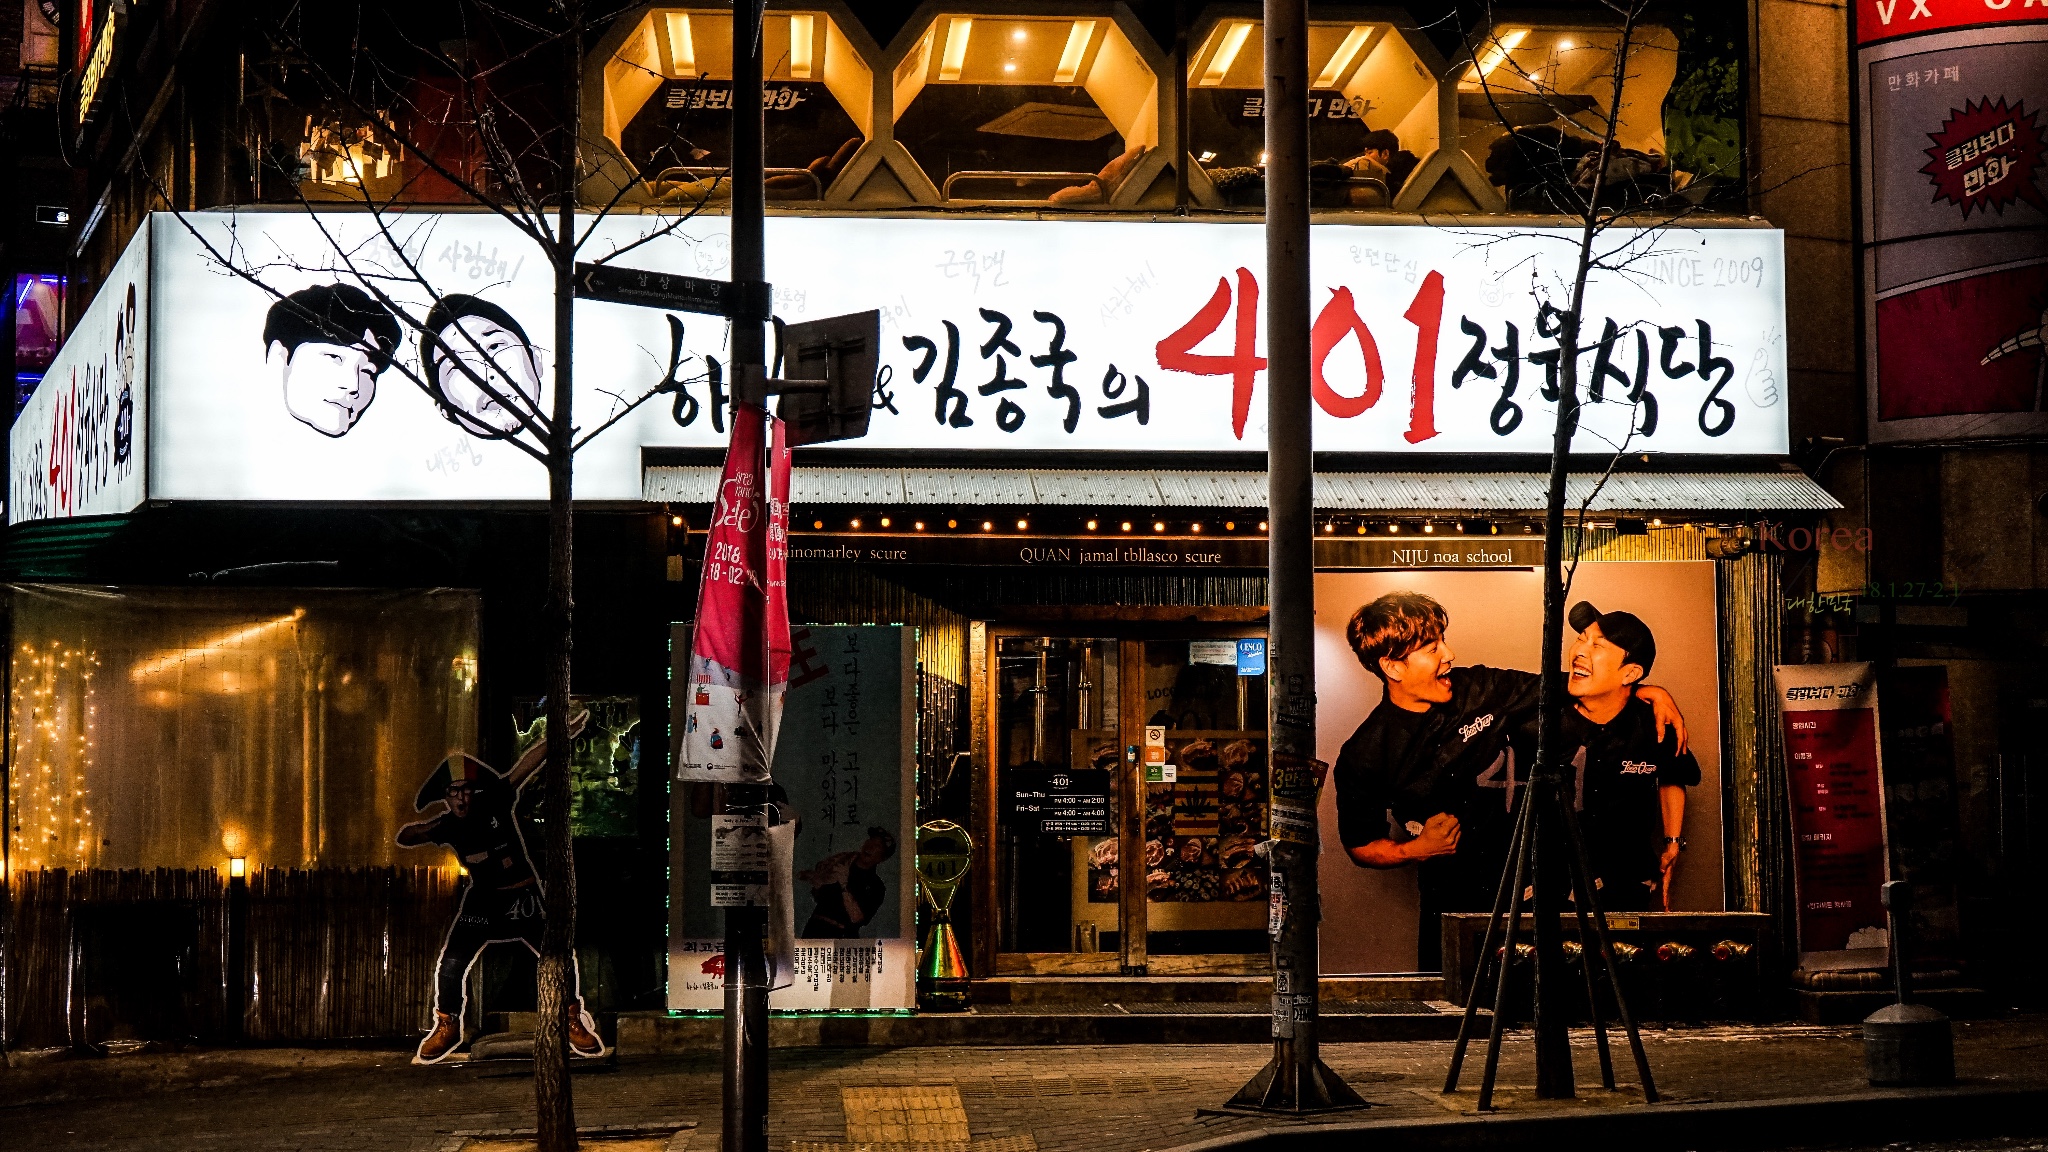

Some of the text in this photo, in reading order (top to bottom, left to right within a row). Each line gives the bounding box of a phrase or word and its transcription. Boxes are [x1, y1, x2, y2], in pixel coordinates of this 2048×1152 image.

[1888, 66, 1960, 91] 만화카페
[1327, 94, 1377, 119] 만화
[1945, 121, 2016, 171] 클럽보다
[1963, 154, 2018, 197] 만화
[438, 239, 525, 288] 사랑해!
[935, 249, 1010, 295] 근육맨
[1713, 256, 1764, 288] 2009
[638, 273, 721, 297] 상상마당
[902, 307, 1150, 434] 김종국의
[1155, 267, 1446, 444] 401
[870, 549, 907, 560] scure
[1019, 547, 1071, 563] QUAN
[1078, 547, 1119, 565] jamal
[1184, 552, 1221, 564] scure
[1392, 549, 1513, 566] NIJU noa school
[821, 685, 839, 852] 보다 맛있게!
[842, 751, 861, 826] 고기로
